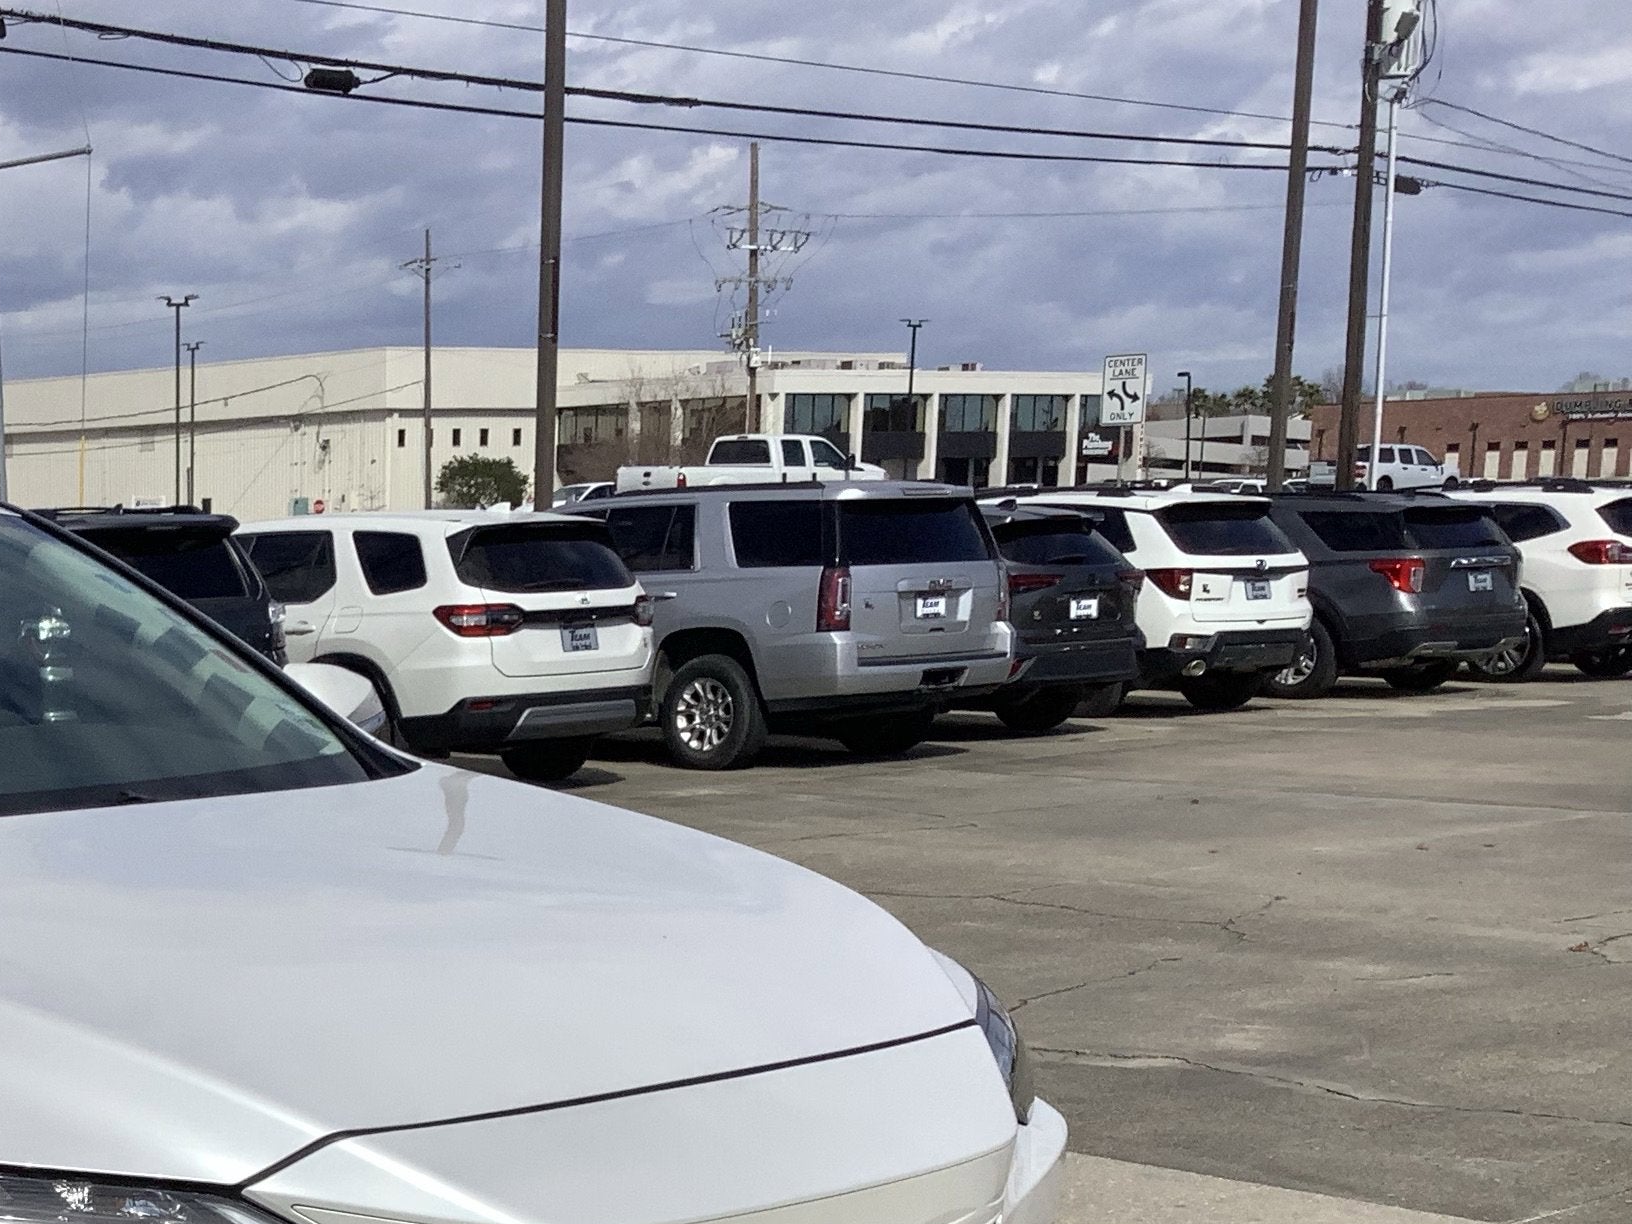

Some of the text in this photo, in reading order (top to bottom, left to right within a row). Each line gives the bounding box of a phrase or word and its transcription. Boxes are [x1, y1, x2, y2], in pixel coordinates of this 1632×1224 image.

[1108, 358, 1144, 369] CENTER
[1112, 368, 1137, 377] LANE
[1109, 412, 1135, 421] ONLY
